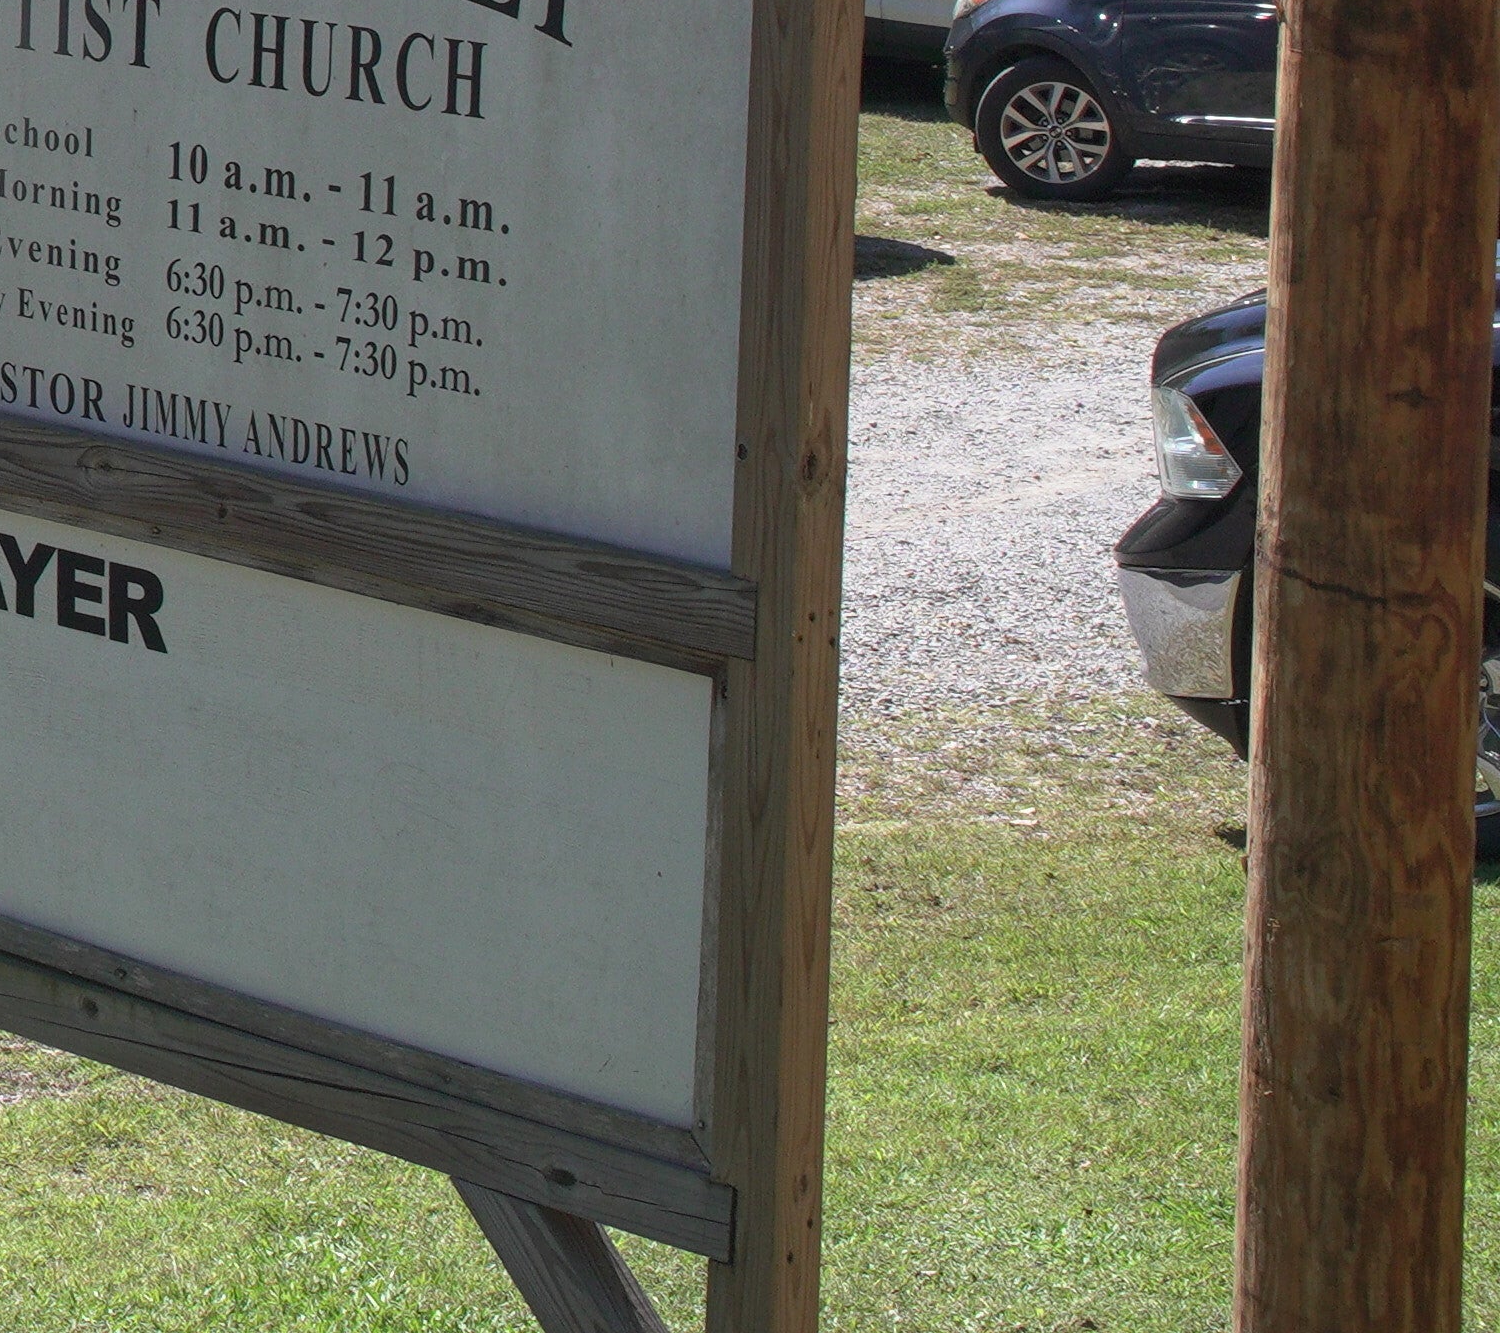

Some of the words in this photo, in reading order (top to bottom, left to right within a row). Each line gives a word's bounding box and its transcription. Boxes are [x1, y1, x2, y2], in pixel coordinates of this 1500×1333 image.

[206, 7, 487, 119] CHURCH
[168, 141, 208, 184] 10
[224, 161, 311, 203] a.m.
[359, 172, 398, 217] 11
[416, 192, 510, 235] a.m.
[167, 199, 204, 234] 11
[219, 216, 305, 252] a.m.
[353, 231, 395, 267] 12
[413, 249, 507, 286] p.m.
[17, 287, 135, 348] Evening
[166, 306, 224, 347] 6:30
[233, 327, 302, 364] p.m.
[335, 336, 397, 380] 7:30
[407, 359, 481, 397] p.m.
[167, 258, 224, 299] 6:30
[234, 280, 303, 316] p.m.
[336, 287, 398, 331] 7:30
[408, 310, 483, 348] p.m.
[123, 384, 231, 448] JIMMY
[243, 409, 409, 486] ANDREWS
